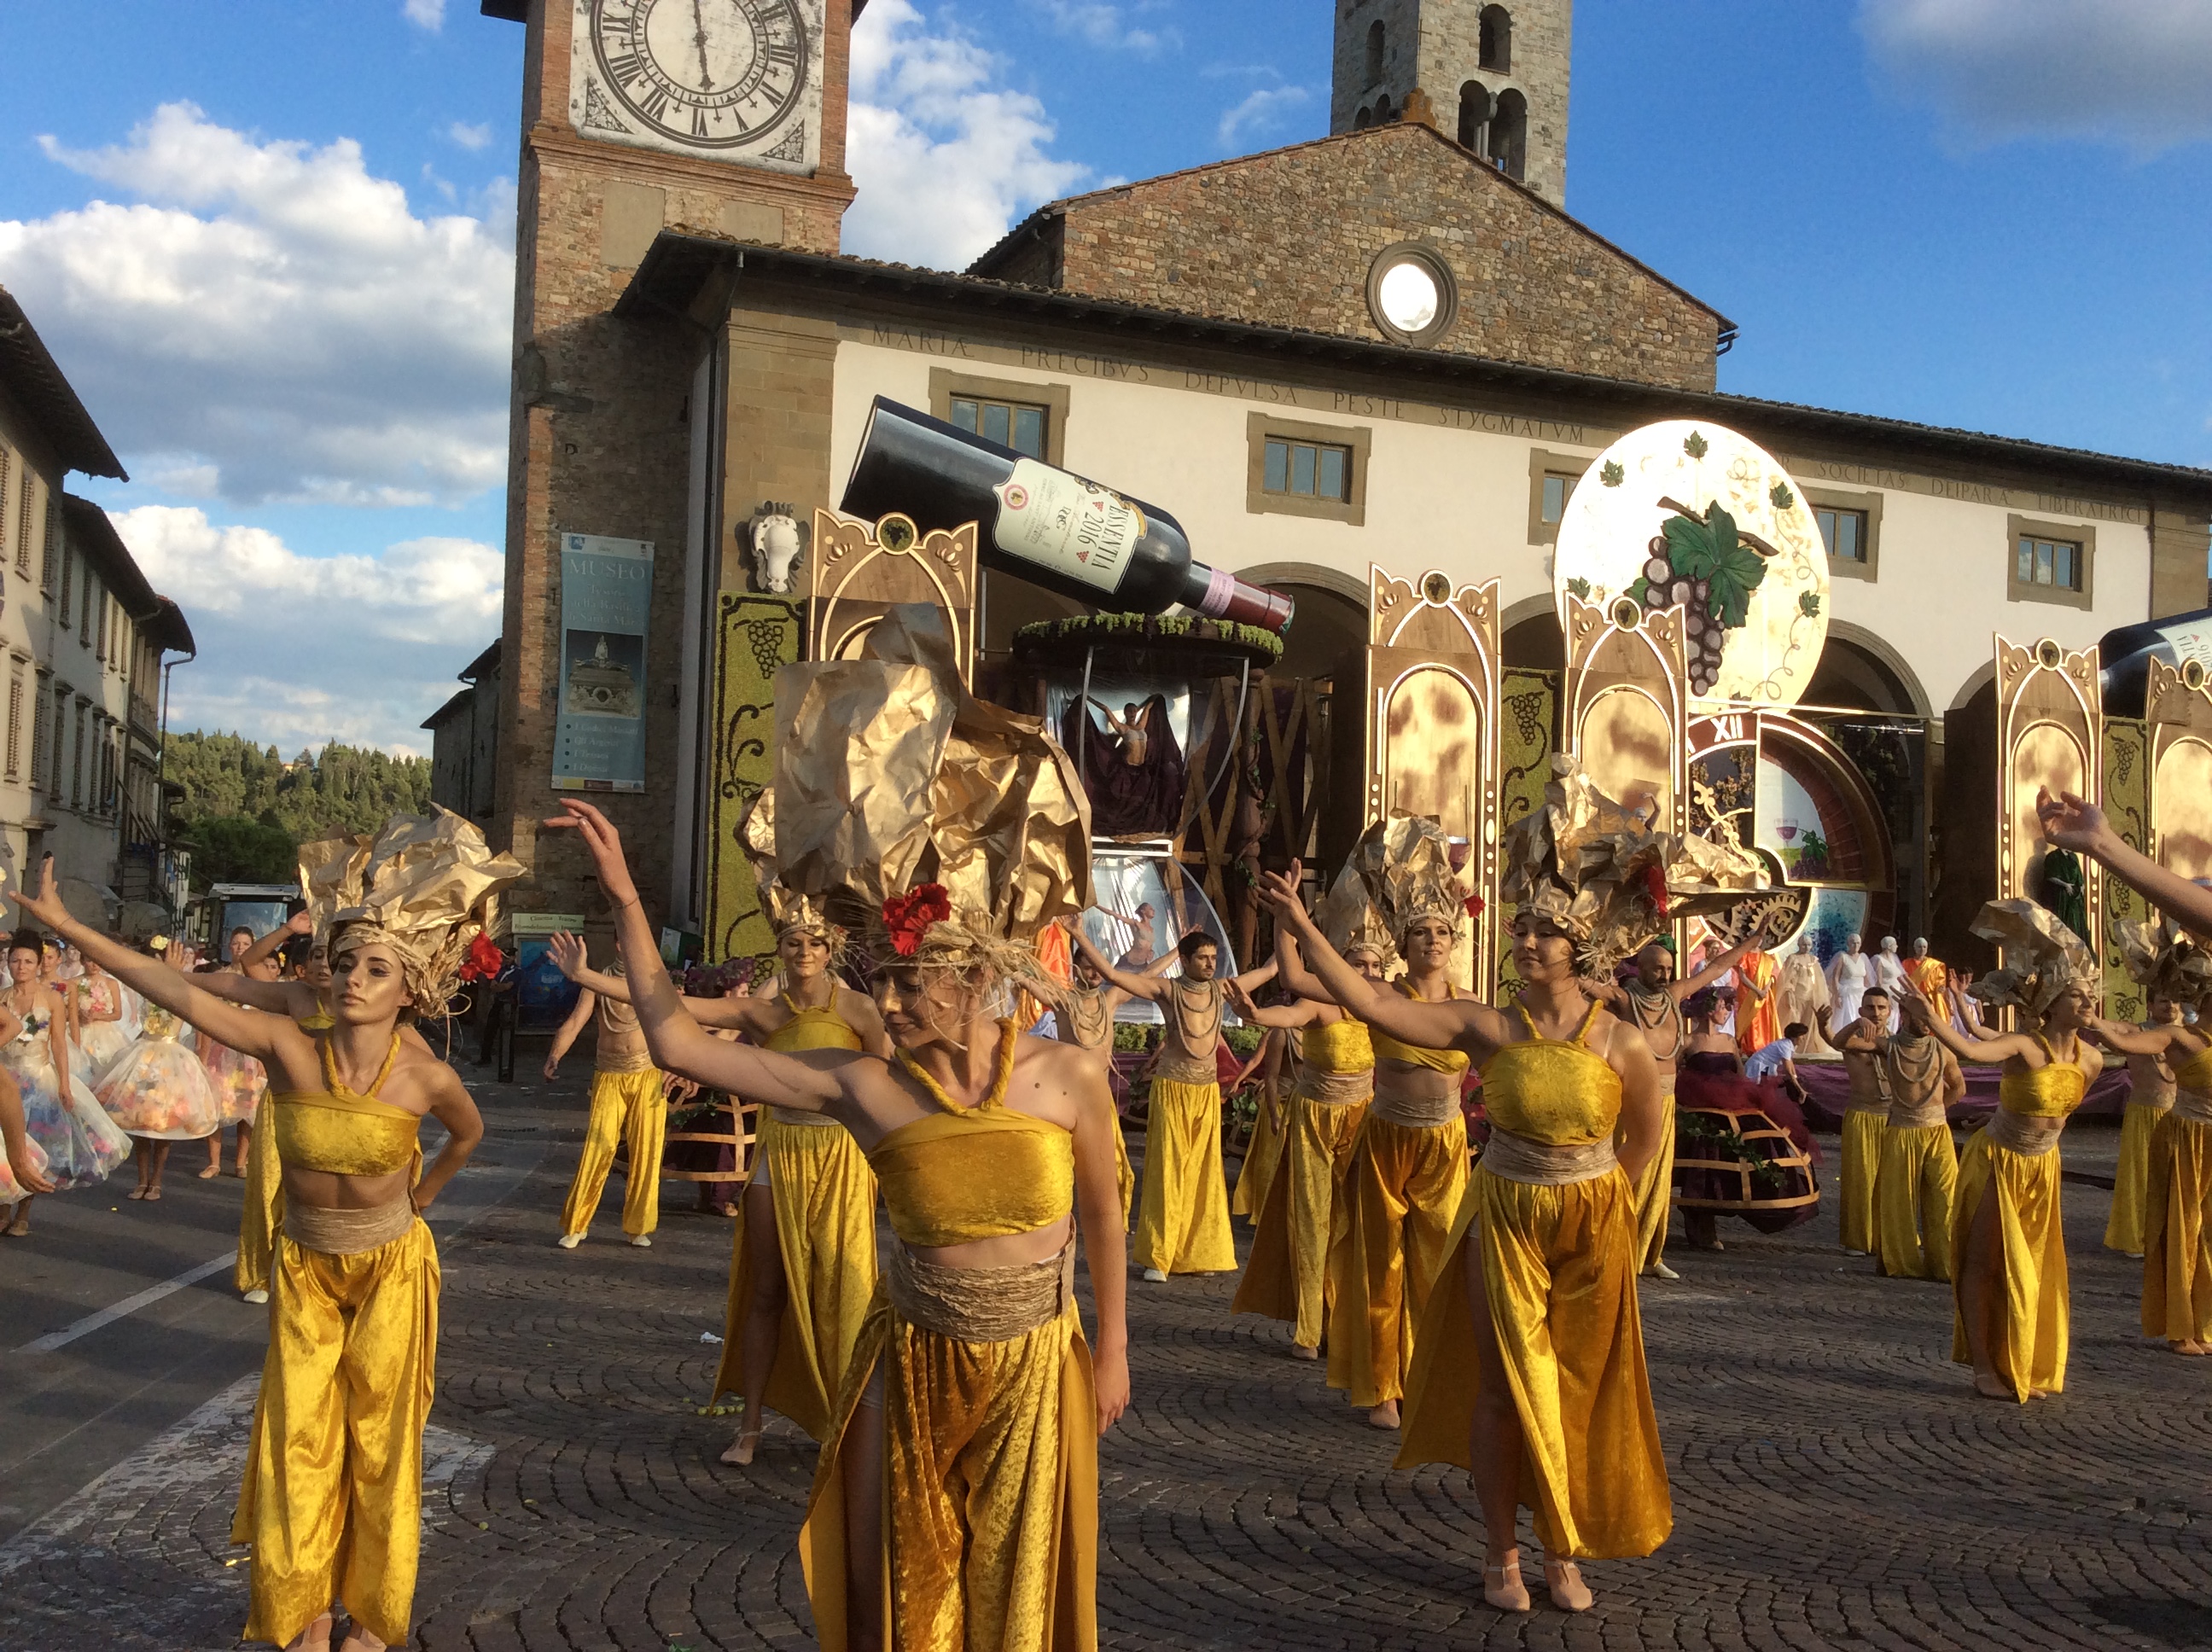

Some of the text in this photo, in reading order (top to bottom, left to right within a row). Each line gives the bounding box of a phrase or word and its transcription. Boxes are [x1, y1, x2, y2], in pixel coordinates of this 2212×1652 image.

[1021, 345, 1150, 382] PRECIBVS
[1185, 370, 1299, 405] DEPVLSA
[1333, 391, 1406, 420] PESTE
[1817, 461, 1906, 489] SOCIETAS
[1077, 511, 1105, 549] 2016
[1091, 504, 1130, 571] ESSENTIA
[569, 558, 646, 581] MUSEO
[1709, 714, 1744, 743] XII
